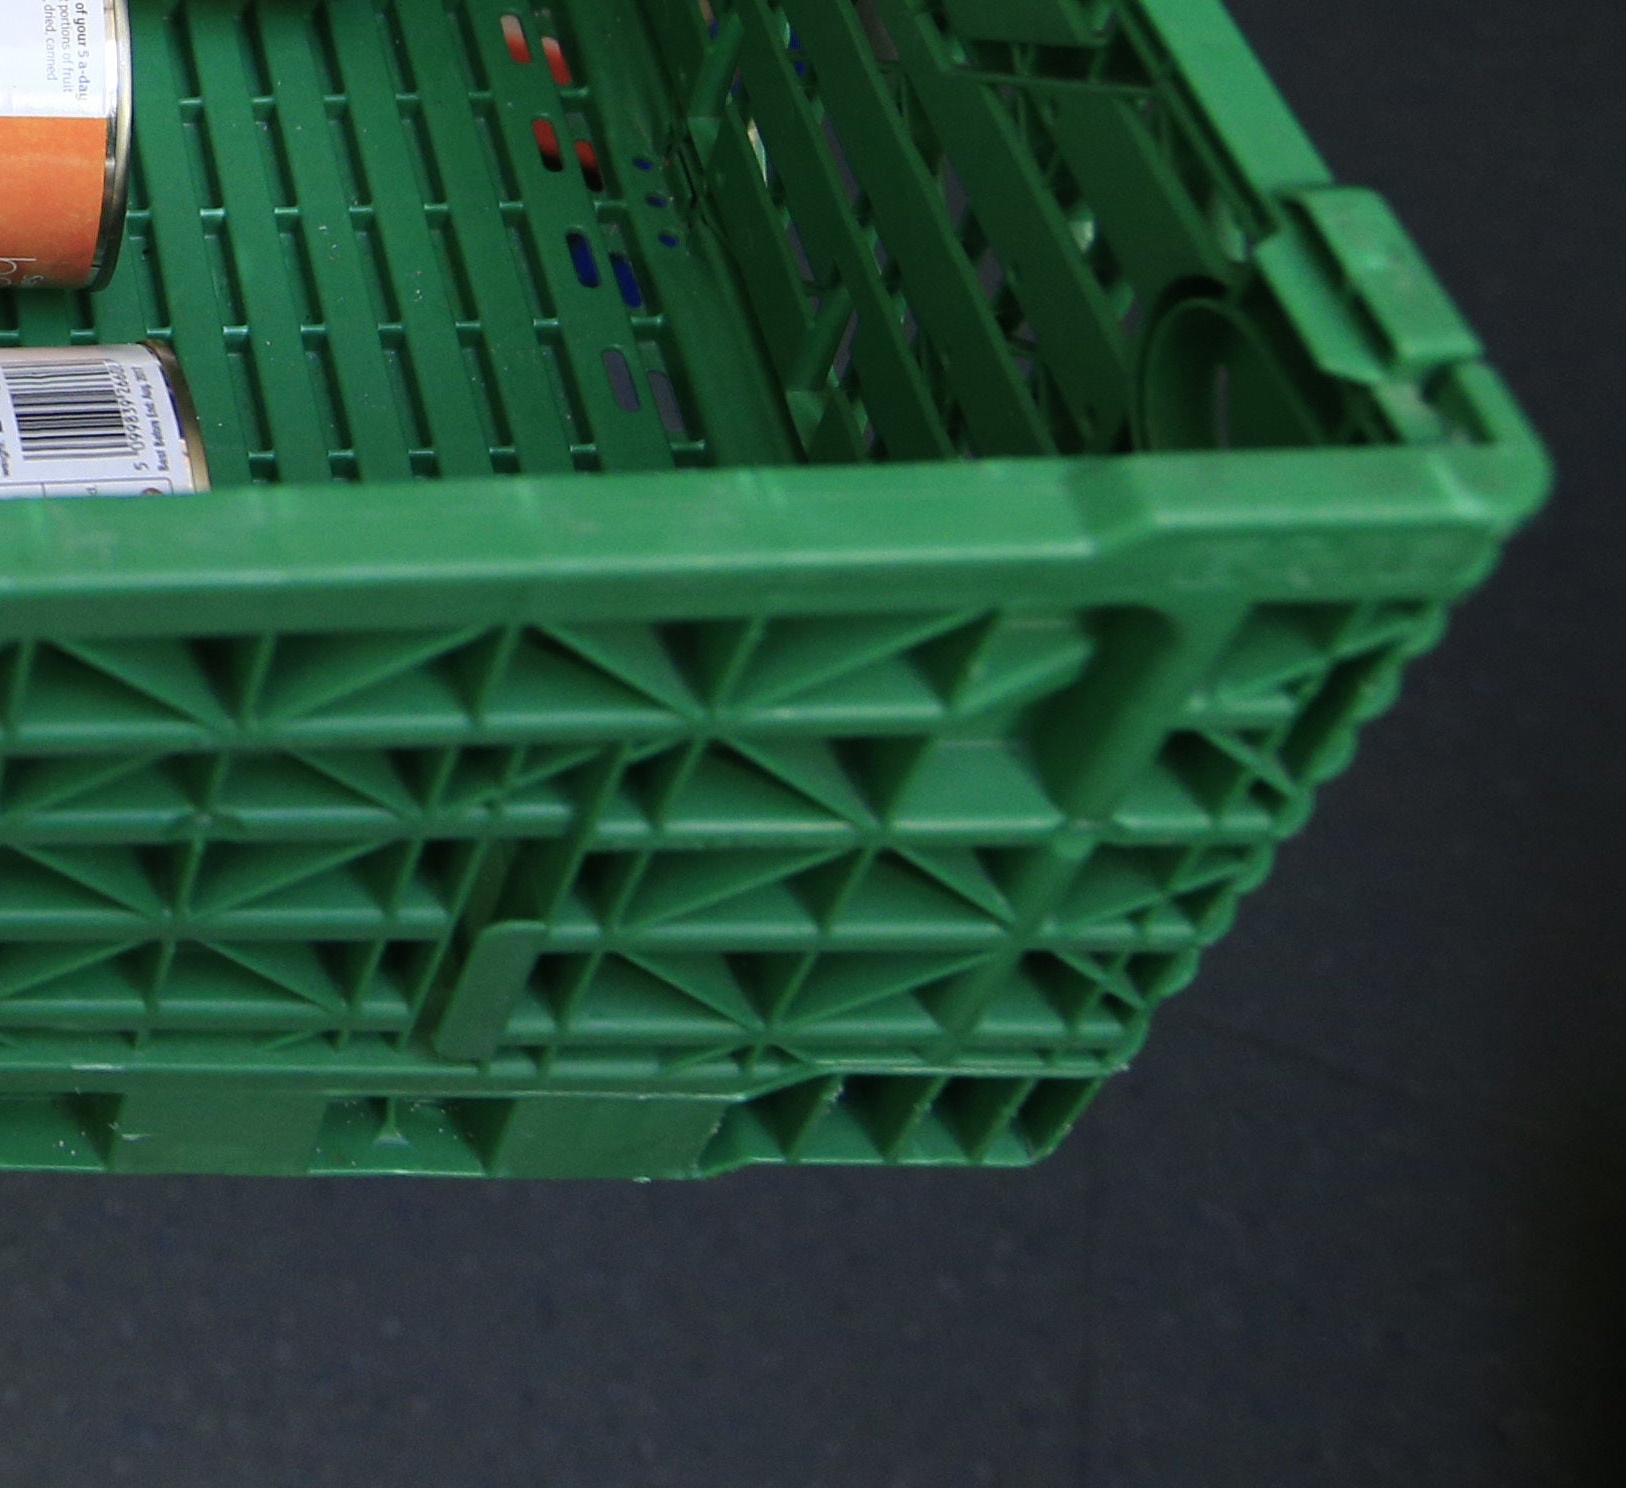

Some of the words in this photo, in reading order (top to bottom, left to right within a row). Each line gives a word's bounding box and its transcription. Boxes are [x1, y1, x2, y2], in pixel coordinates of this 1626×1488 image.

[75, 2, 87, 15] of
[57, 5, 73, 49] portions
[73, 18, 88, 46] your
[45, 37, 58, 81] canned
[62, 68, 75, 93] fruit
[74, 61, 90, 101] a-day
[134, 462, 150, 471] 5
